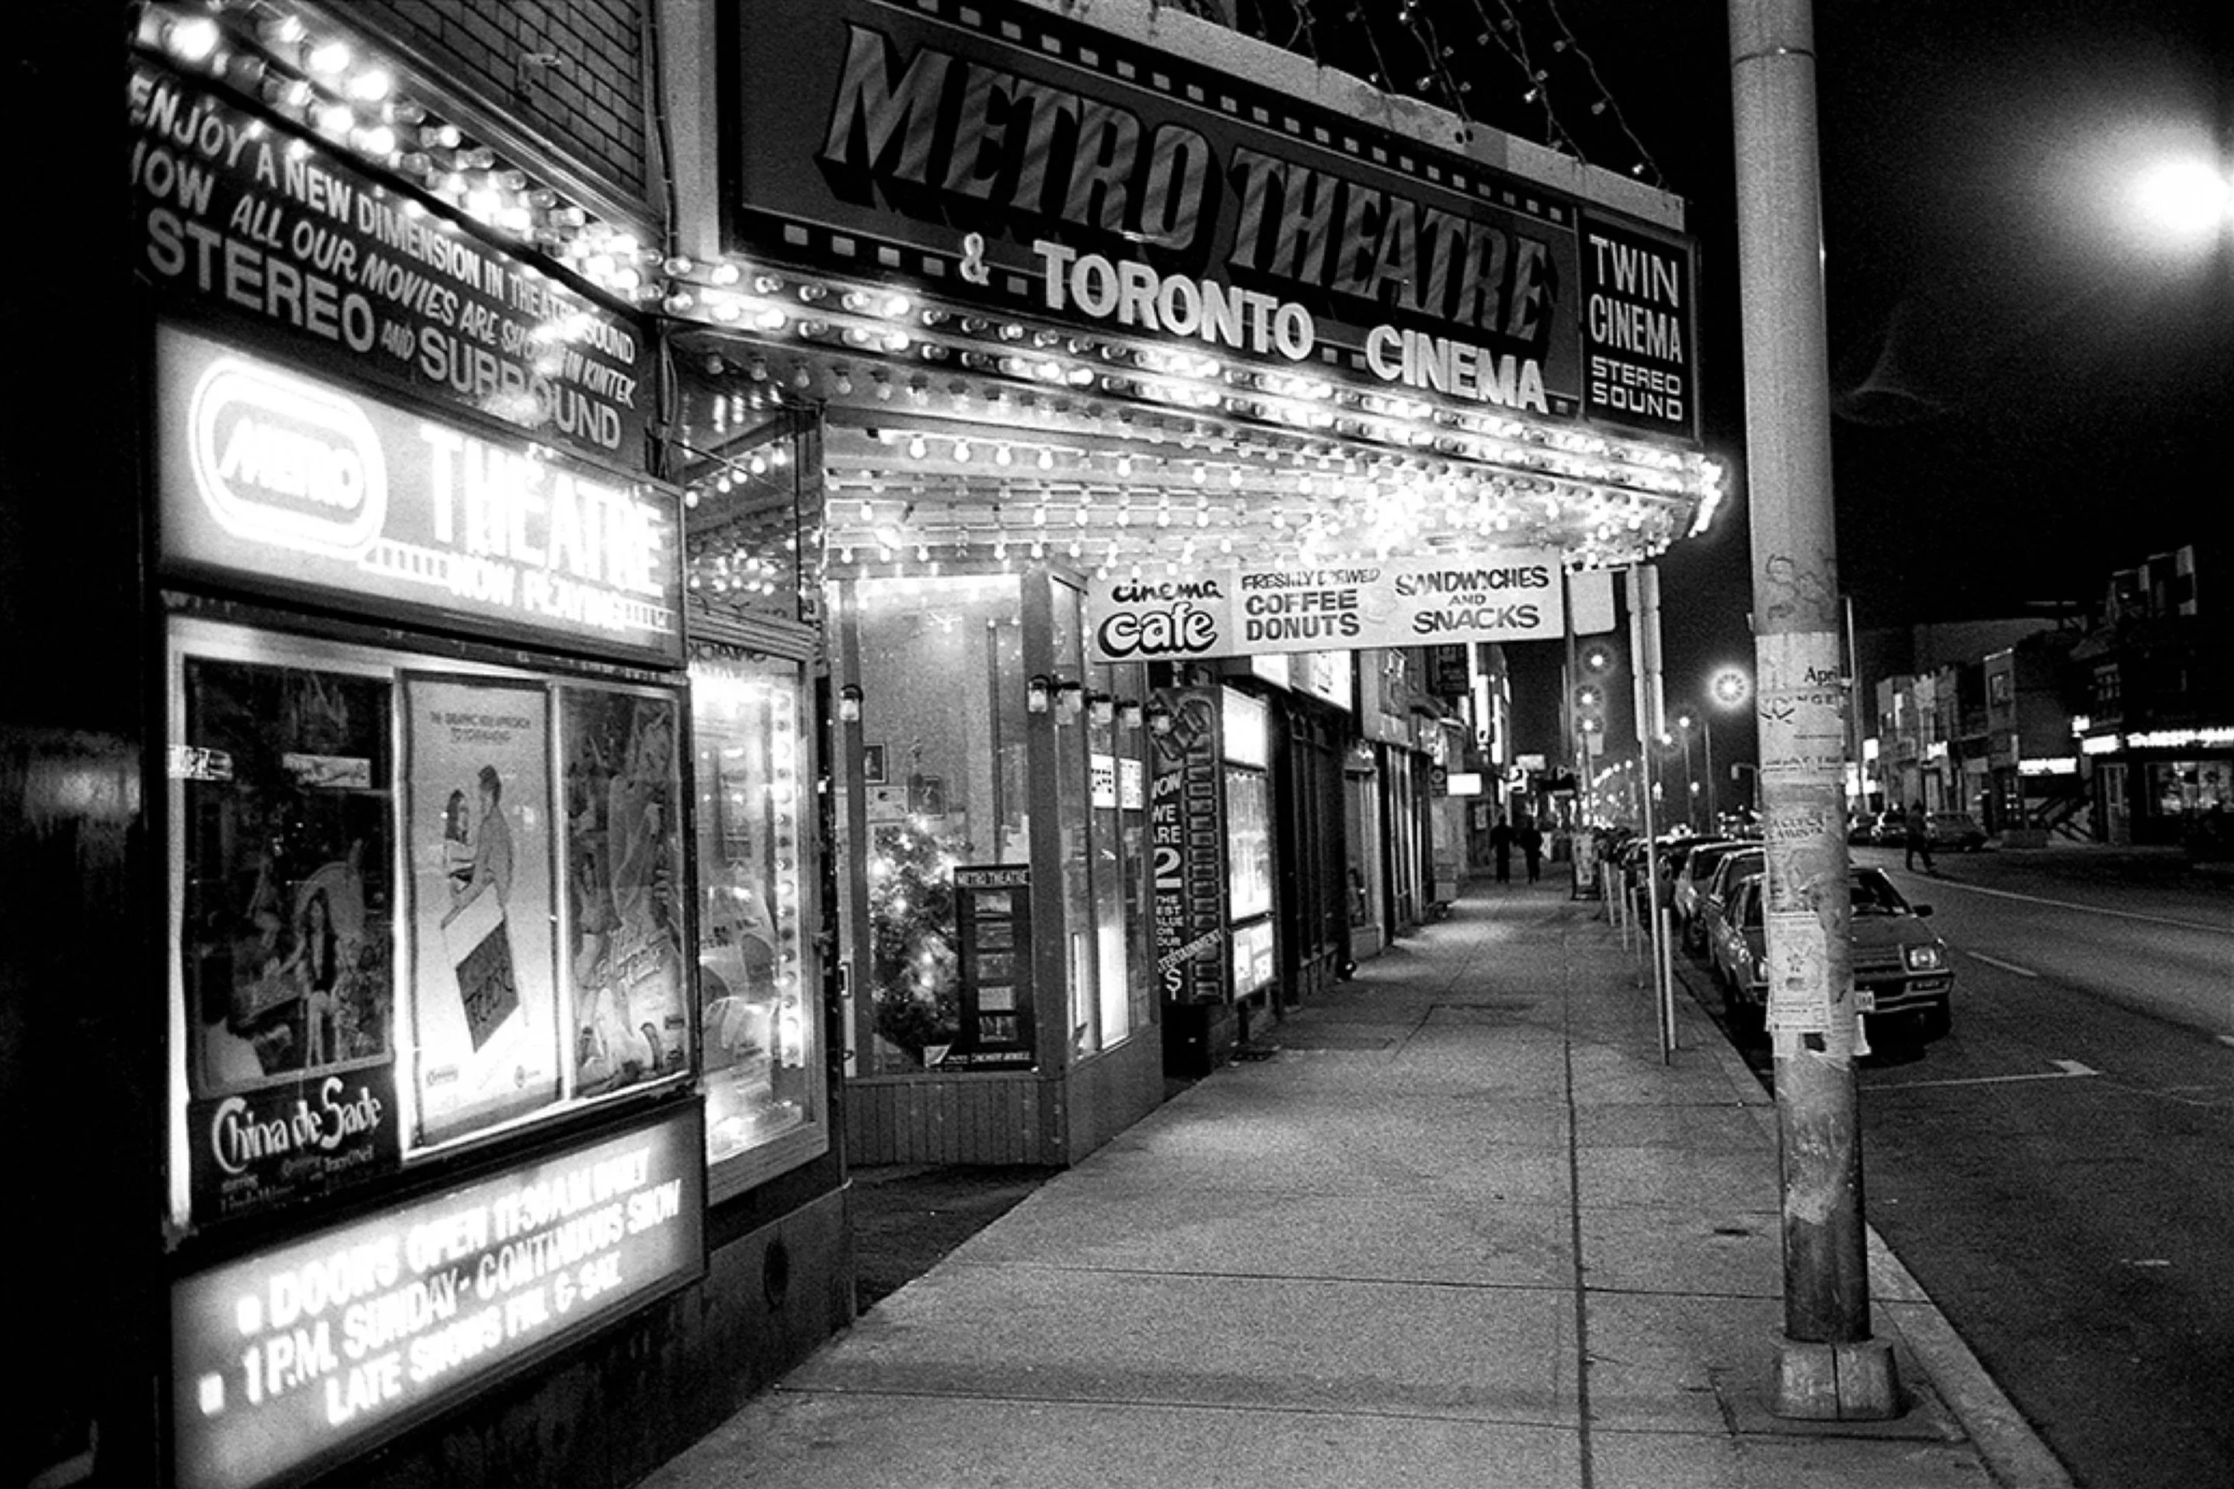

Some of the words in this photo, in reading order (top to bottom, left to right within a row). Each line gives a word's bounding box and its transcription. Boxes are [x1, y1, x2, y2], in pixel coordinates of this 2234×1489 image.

[129, 74, 251, 167] ENJOY
[257, 143, 278, 187] A
[284, 148, 351, 225] NEW
[357, 186, 481, 288] DIMENSION
[485, 256, 505, 301] IN
[822, 22, 1210, 251] METRO
[1229, 145, 1556, 343] THEATRE
[230, 193, 284, 250] ALL
[292, 219, 359, 283] OUR
[361, 254, 460, 323] MOVIES
[459, 303, 500, 345] ARE
[1590, 233, 1680, 306] TWIN
[147, 205, 375, 354] STEREO
[380, 318, 415, 361] AND
[418, 327, 621, 450] SURROUND
[959, 232, 990, 287] &
[1033, 238, 1315, 362] TORONTO
[1365, 324, 1549, 415] CINEMA
[1590, 296, 1683, 364] CINEMA
[1591, 357, 1682, 396] STEREO
[1591, 380, 1684, 421] SOUND
[420, 423, 664, 597] THEATRE
[1111, 580, 1225, 603] cinema
[1245, 588, 1358, 616] COFFEE
[1395, 566, 1550, 597] SANDWICHES
[1449, 593, 1486, 606] AND
[1098, 601, 1218, 658] cafe
[1246, 612, 1361, 642] DONUTS
[1412, 605, 1541, 635] SNACKS
[1154, 846, 1183, 889] 2
[212, 1096, 290, 1174] China
[291, 1100, 323, 1148] de
[319, 1076, 383, 1149] Sade
[268, 1235, 399, 1329] DOORS
[406, 1206, 488, 1271] OPEN
[242, 1347, 262, 1404] 1
[342, 1266, 458, 1358] SUNDAY
[477, 1202, 624, 1300] CONTINUOUS
[325, 1351, 402, 1426] LATE
[409, 1304, 502, 1382] SHOWS
[554, 1272, 574, 1313] &
